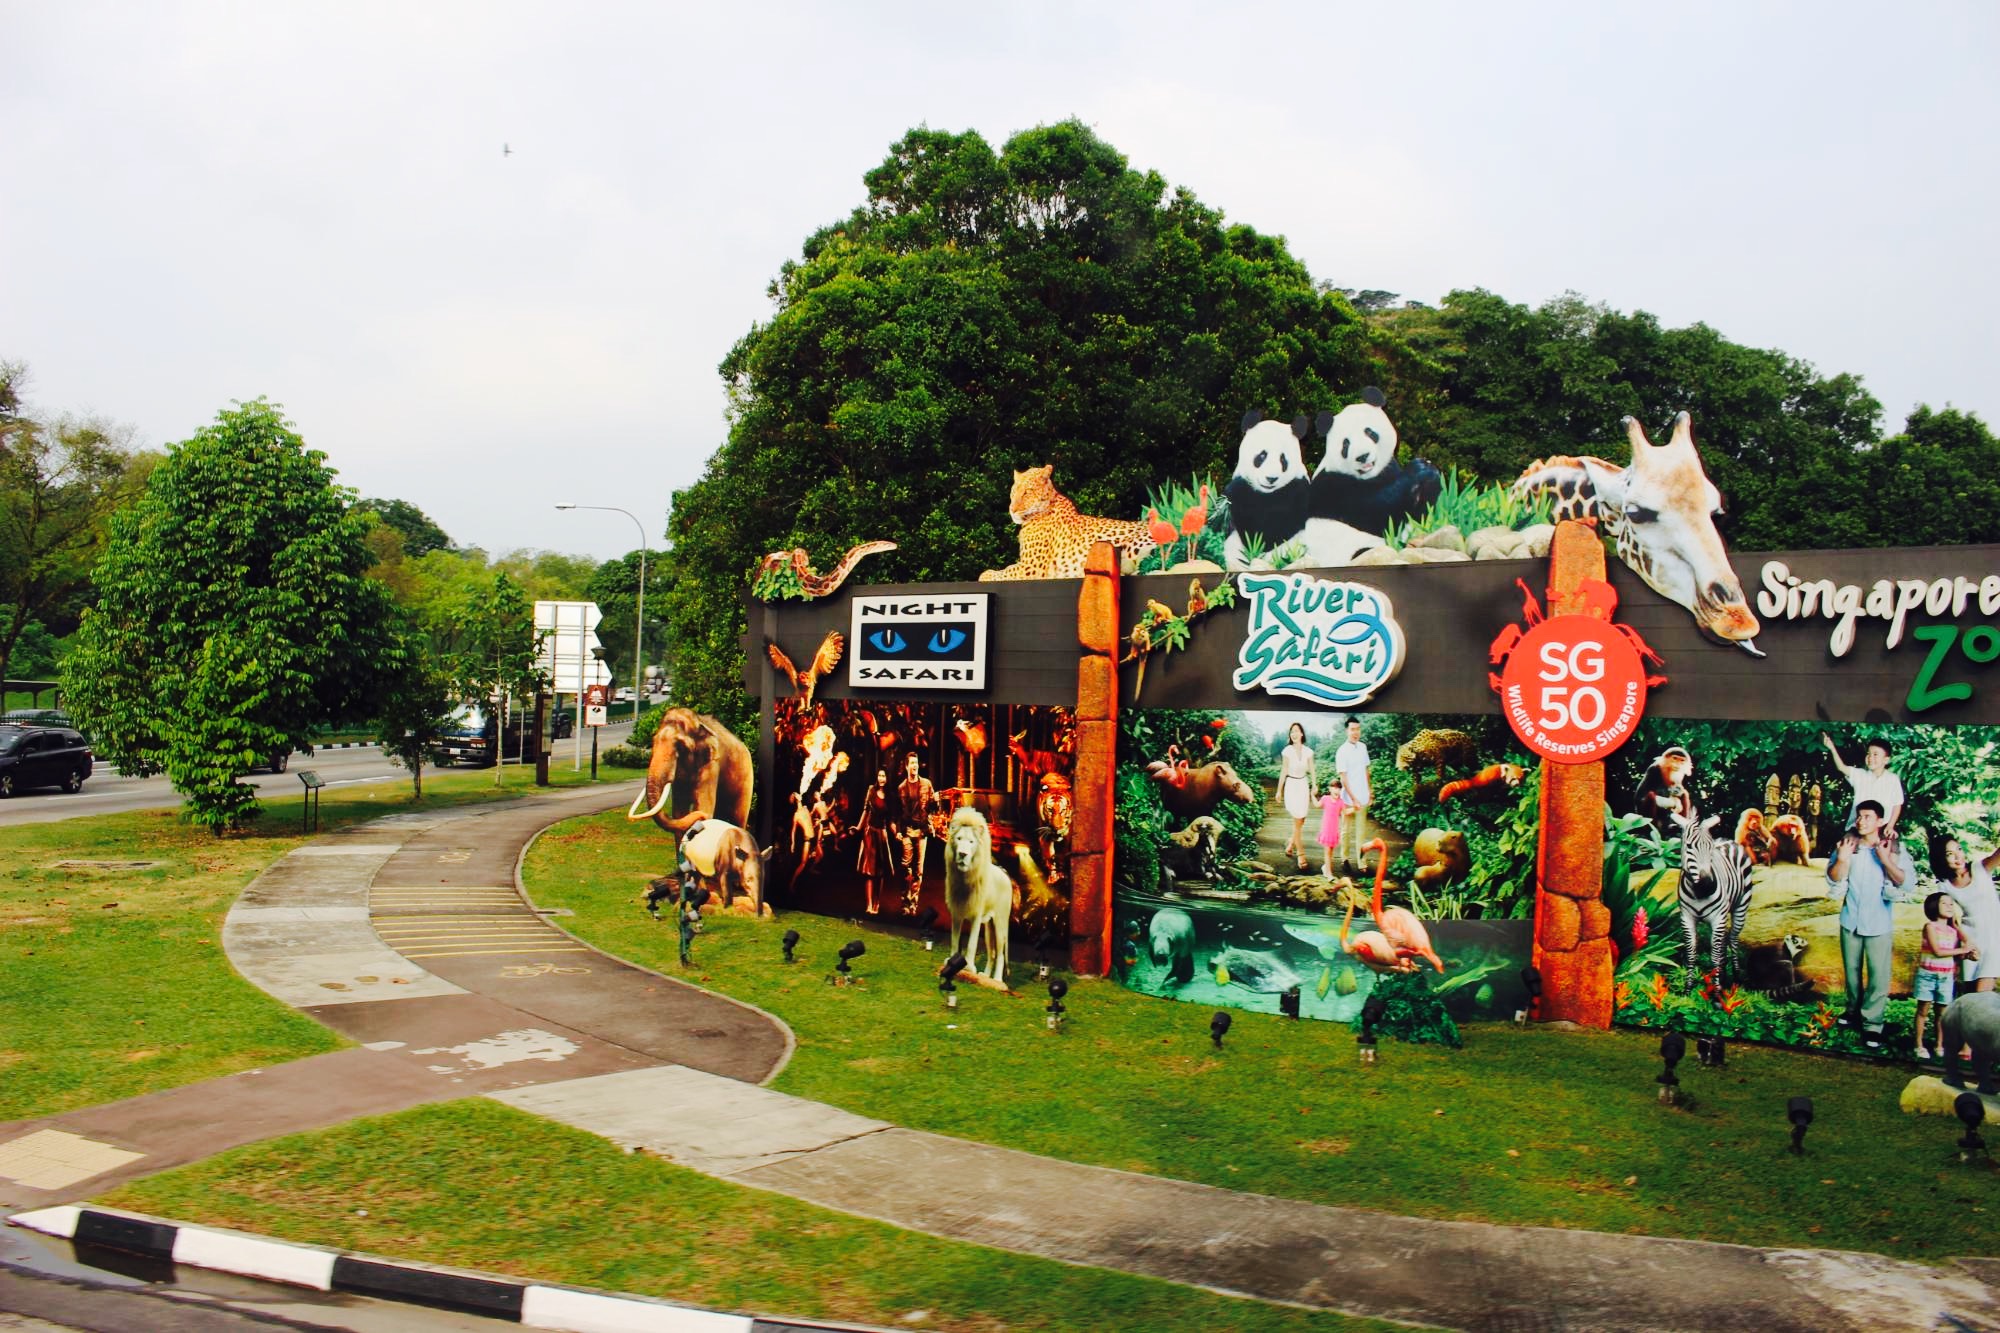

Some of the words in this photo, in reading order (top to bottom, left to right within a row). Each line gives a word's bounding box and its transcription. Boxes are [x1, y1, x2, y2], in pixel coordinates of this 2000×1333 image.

[862, 602, 977, 616] NIGHT
[1244, 578, 1364, 638] River
[1757, 560, 2000, 657] Singapore
[859, 667, 974, 681] SAFARI
[1239, 624, 1377, 685] Safari
[1538, 641, 1605, 682] SG
[1507, 684, 1535, 736] Wildlife
[1534, 731, 1596, 755] Reserves
[1596, 681, 1638, 747] Singapore
[1538, 686, 1607, 731] 50
